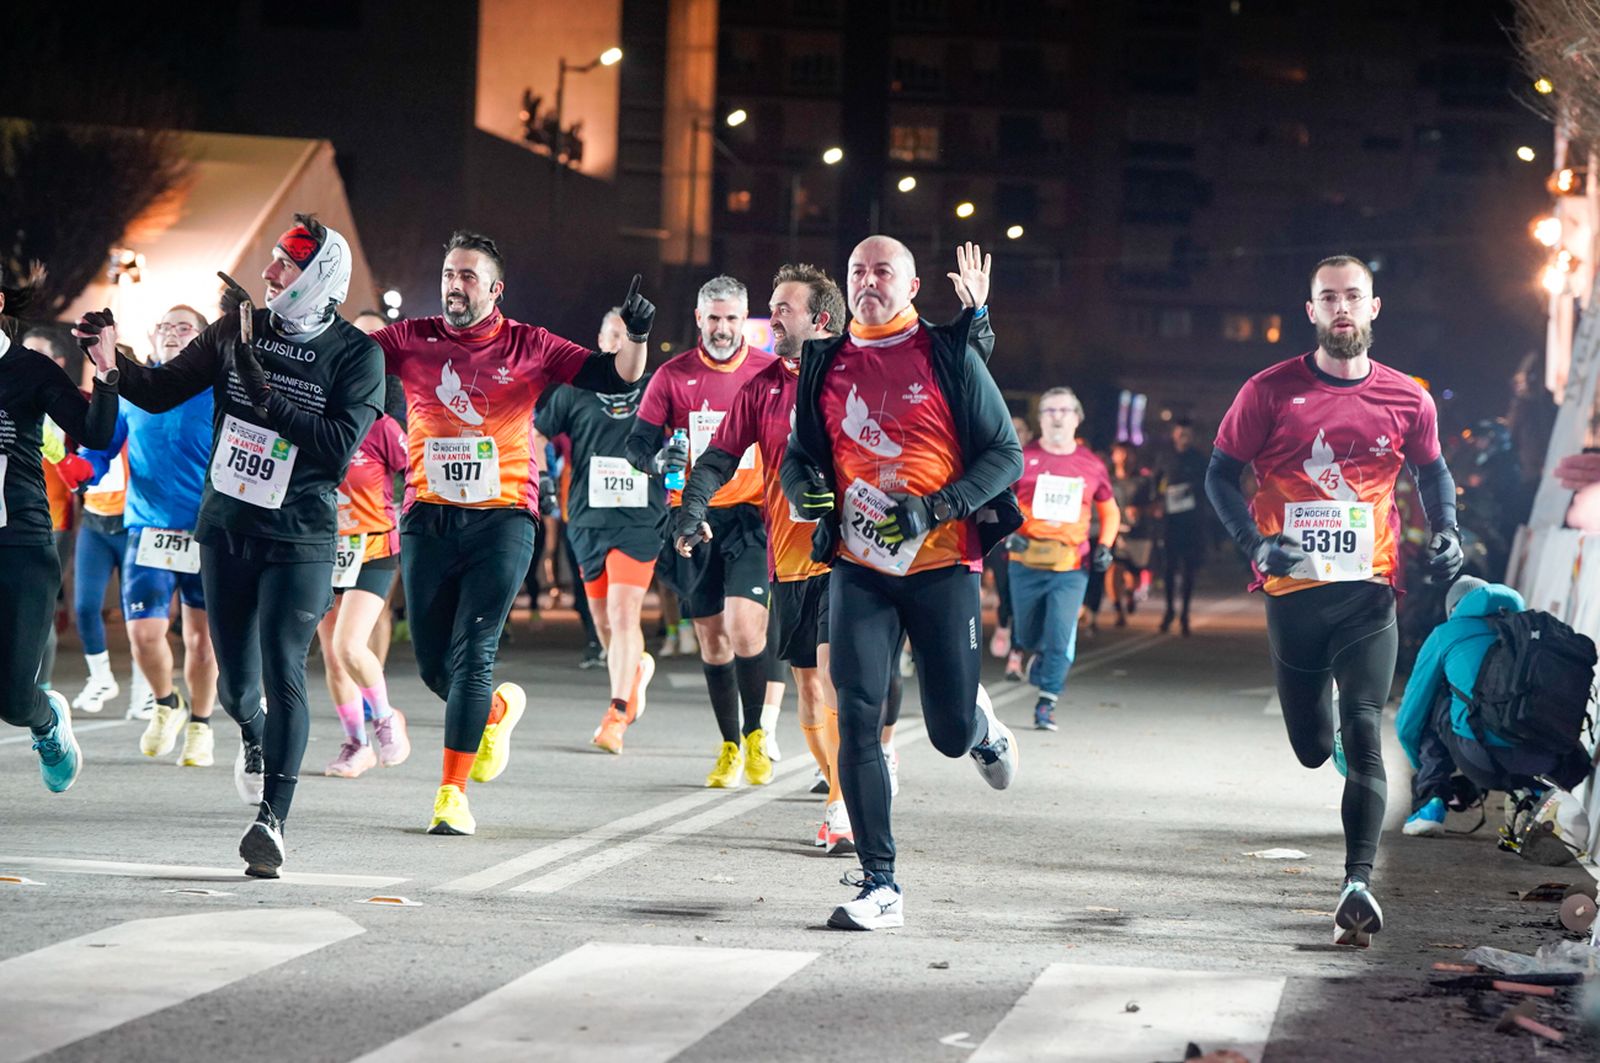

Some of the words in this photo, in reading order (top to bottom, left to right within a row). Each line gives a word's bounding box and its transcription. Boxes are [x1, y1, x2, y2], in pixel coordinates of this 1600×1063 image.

[255, 337, 316, 362] LUISILLO
[271, 373, 324, 395] MANIFESTO:
[449, 395, 469, 413] 43
[859, 425, 880, 447] 43
[227, 446, 275, 480] 7599
[442, 462, 482, 481] 1977
[604, 477, 634, 491] 1219
[1318, 468, 1340, 490] 43
[851, 498, 867, 512] SAN
[867, 507, 887, 523] ANT
[865, 495, 888, 512] NOCH
[1294, 520, 1311, 528] SAN
[1304, 510, 1330, 518] NOCHE
[1332, 510, 1342, 518] DE
[154, 533, 191, 552] 3751
[1301, 530, 1357, 553] 5319
